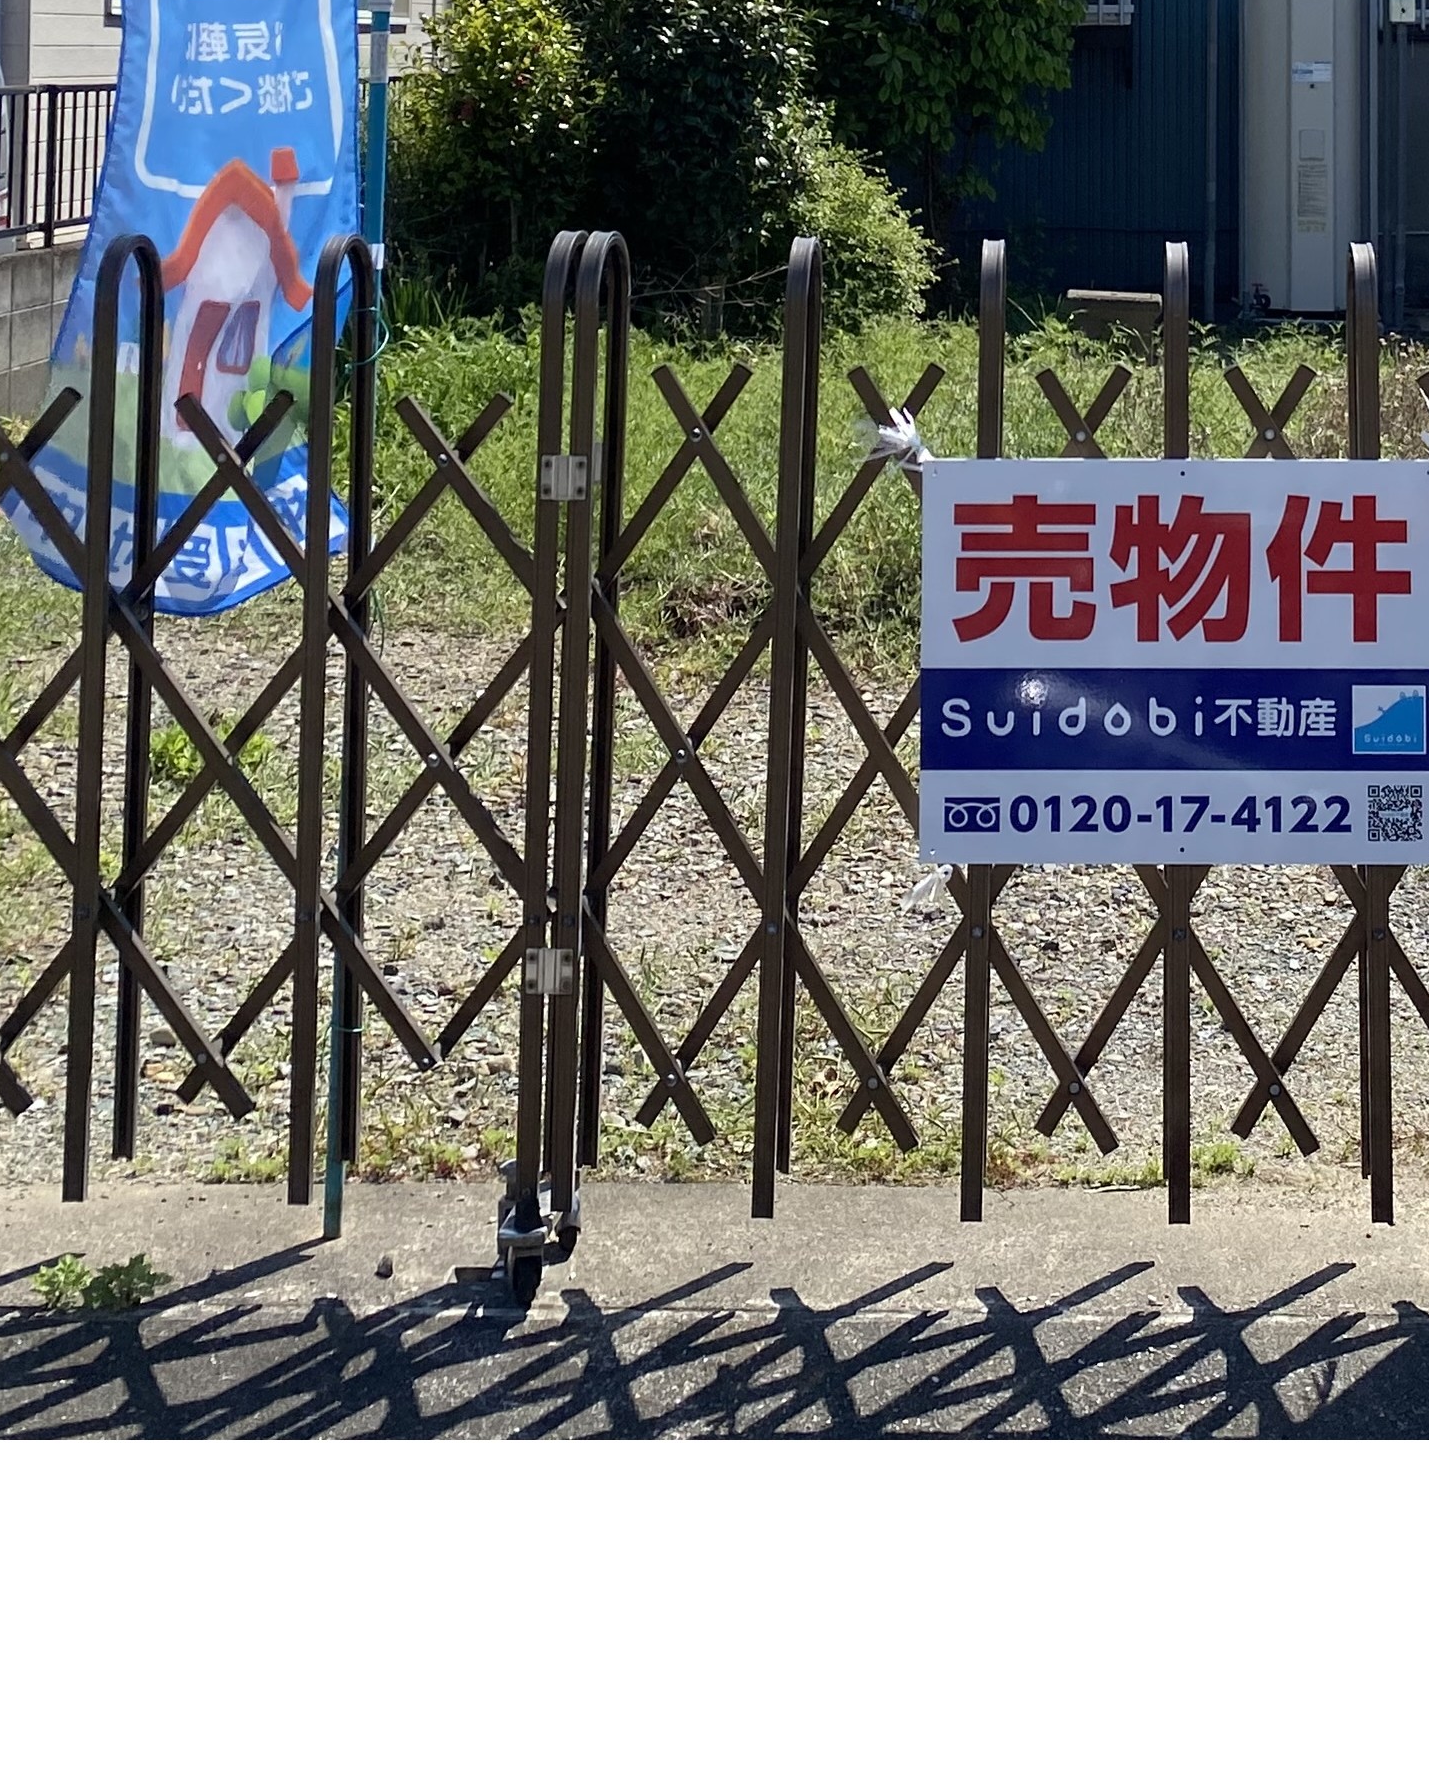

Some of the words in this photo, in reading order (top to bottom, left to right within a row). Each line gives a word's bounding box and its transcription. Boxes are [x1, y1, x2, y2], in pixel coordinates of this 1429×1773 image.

[951, 494, 1412, 643] 売物件
[1009, 795, 1352, 833] 0120-17-4122
